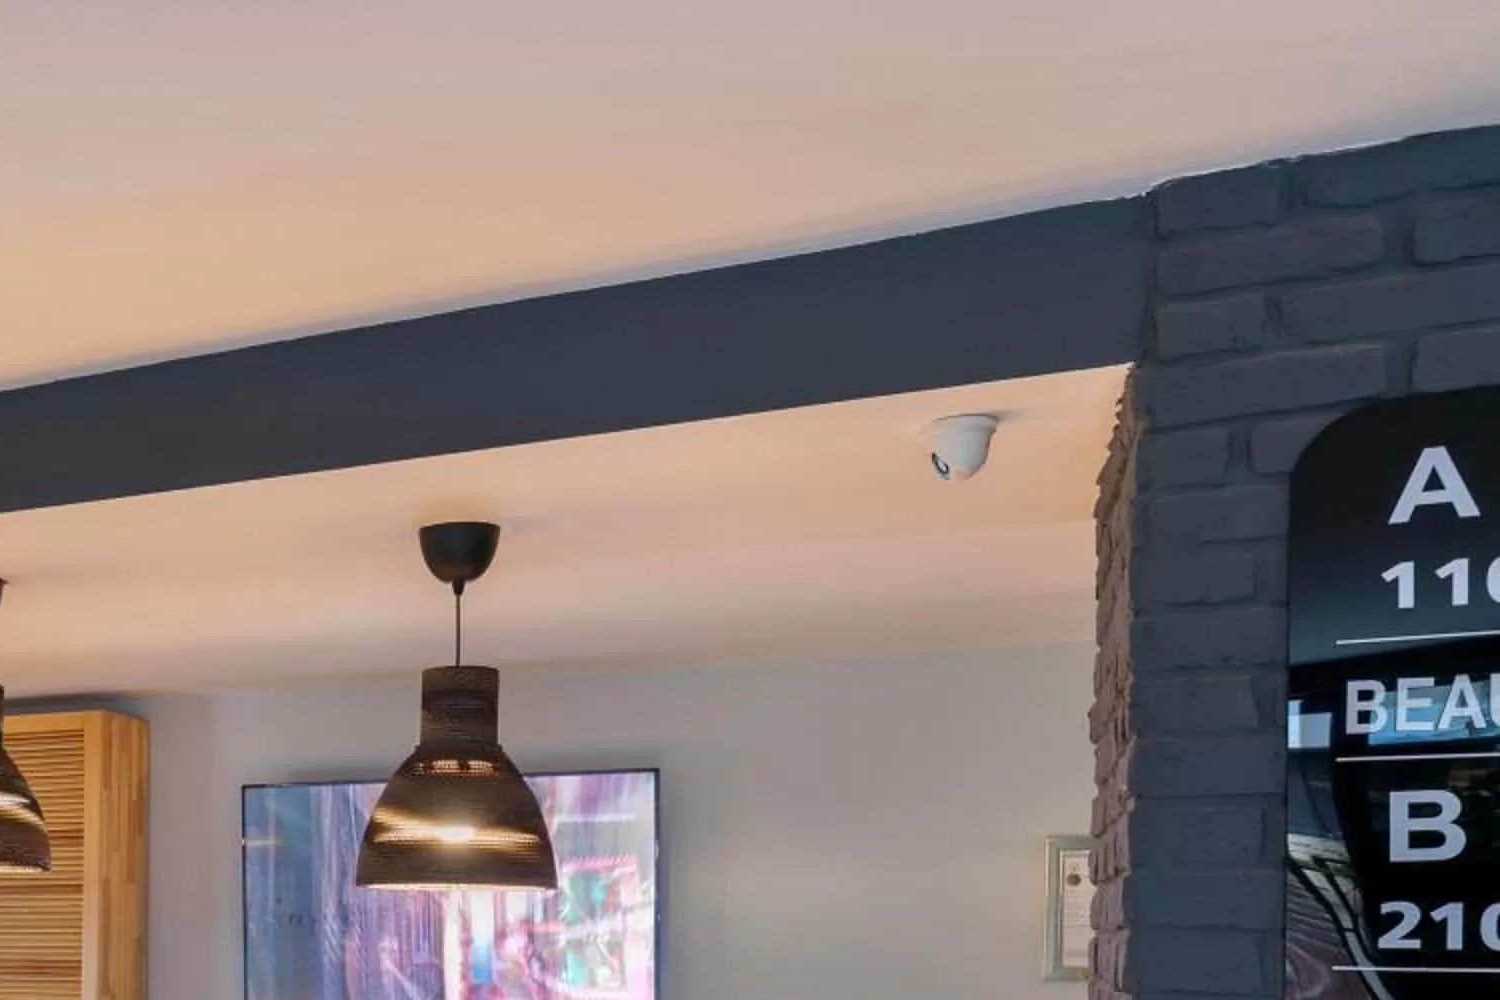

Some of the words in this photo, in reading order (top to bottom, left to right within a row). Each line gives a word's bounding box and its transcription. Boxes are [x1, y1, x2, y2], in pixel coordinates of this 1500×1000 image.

[1388, 445, 1481, 525] A
[1346, 673, 1500, 735] BEA
[1389, 789, 1467, 863] B
